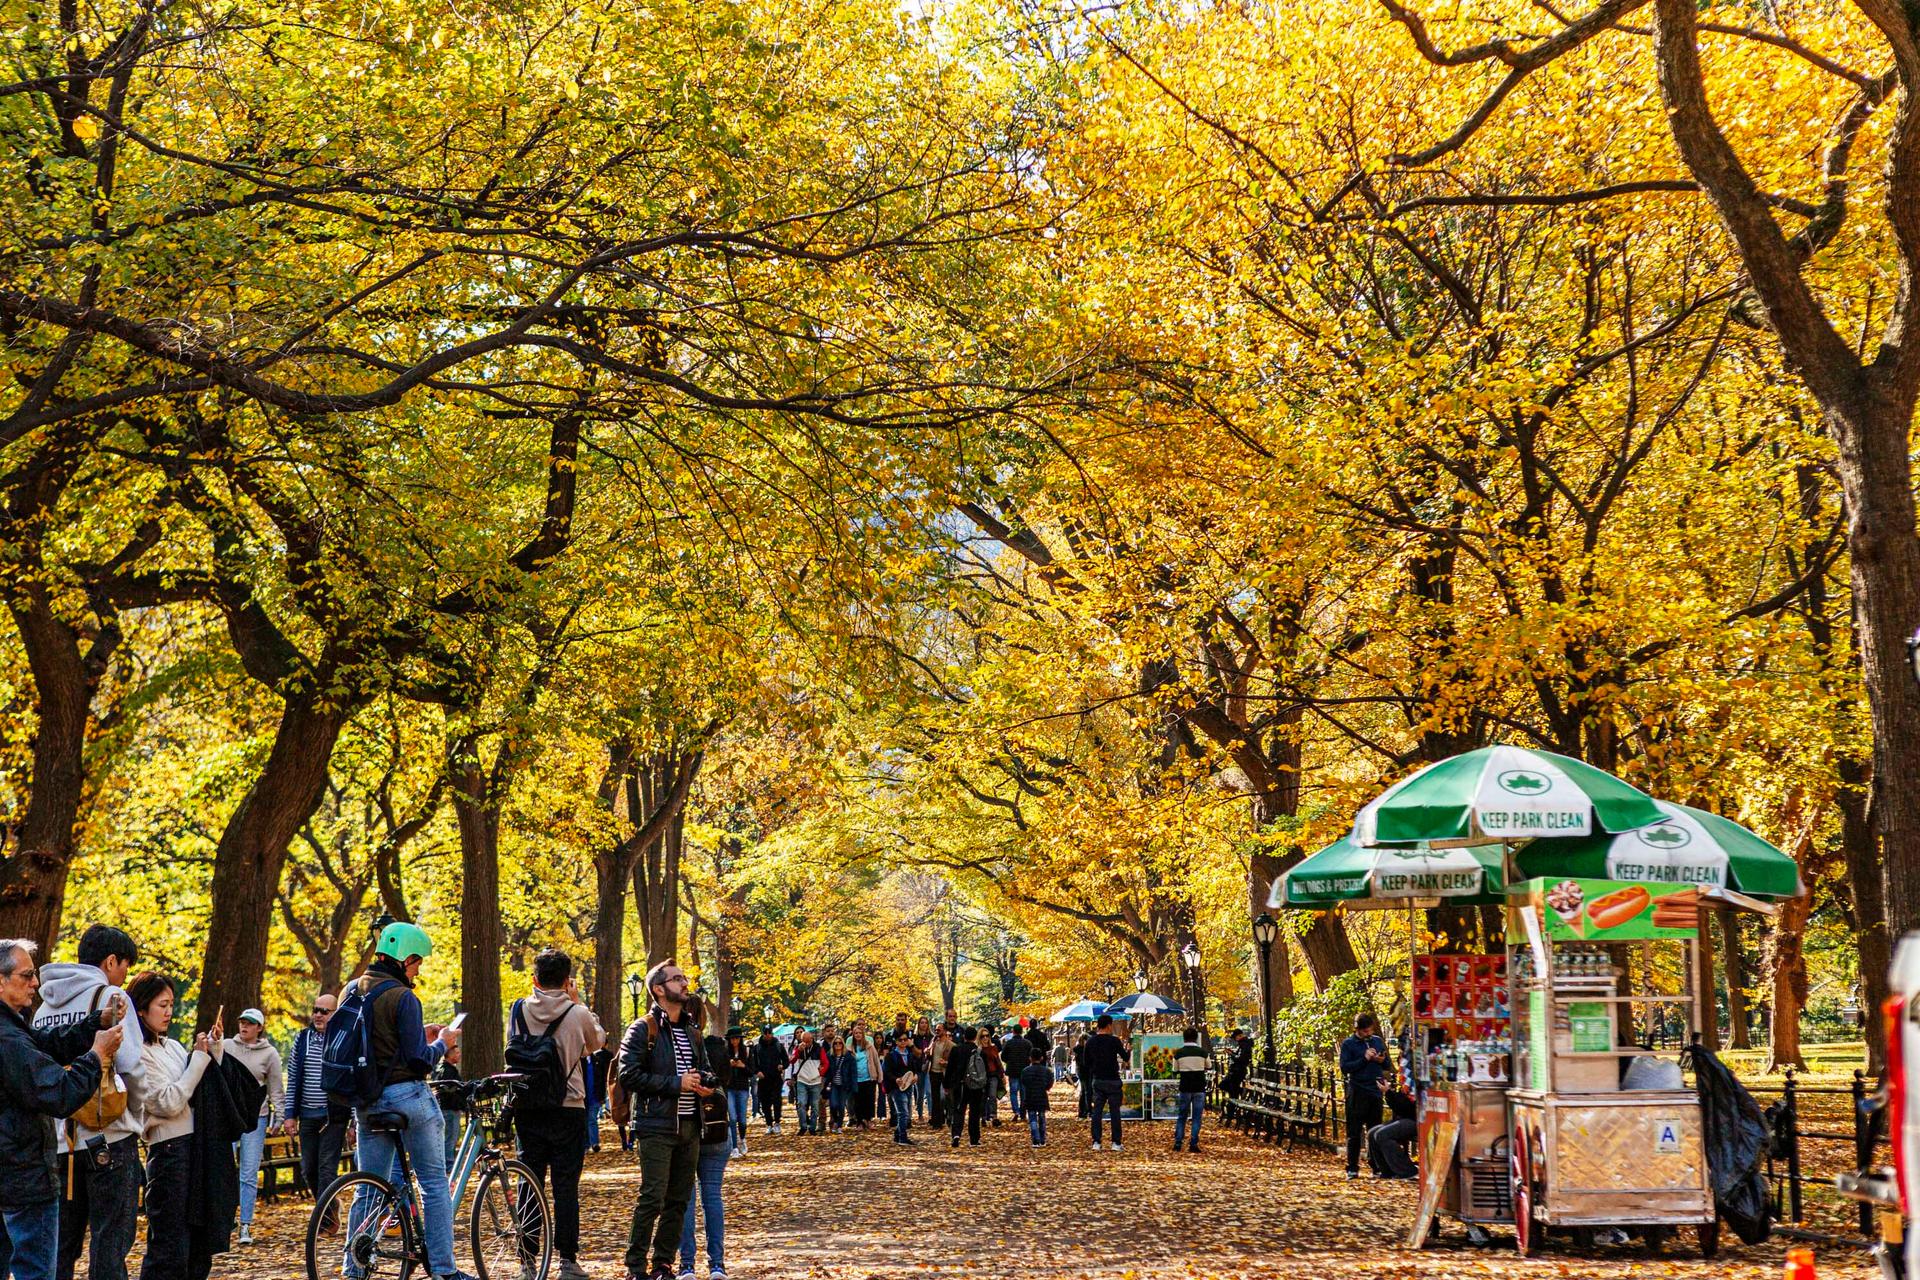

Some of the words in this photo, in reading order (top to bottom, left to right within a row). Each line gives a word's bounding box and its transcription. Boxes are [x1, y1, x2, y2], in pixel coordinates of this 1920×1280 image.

[1481, 812, 1509, 828] KEEP
[1513, 812, 1544, 828] PARK
[1547, 812, 1584, 828] CLEAN
[1616, 863, 1645, 880] KEEP
[1648, 864, 1679, 882] PARK
[1683, 866, 1720, 883] CLEAN
[1307, 880, 1325, 894] DOGS
[1326, 879, 1332, 892] &
[1382, 874, 1407, 890] KEEP
[1411, 874, 1438, 890] PARK
[1442, 873, 1475, 889] CLEAN
[1661, 1126, 1675, 1142] A
